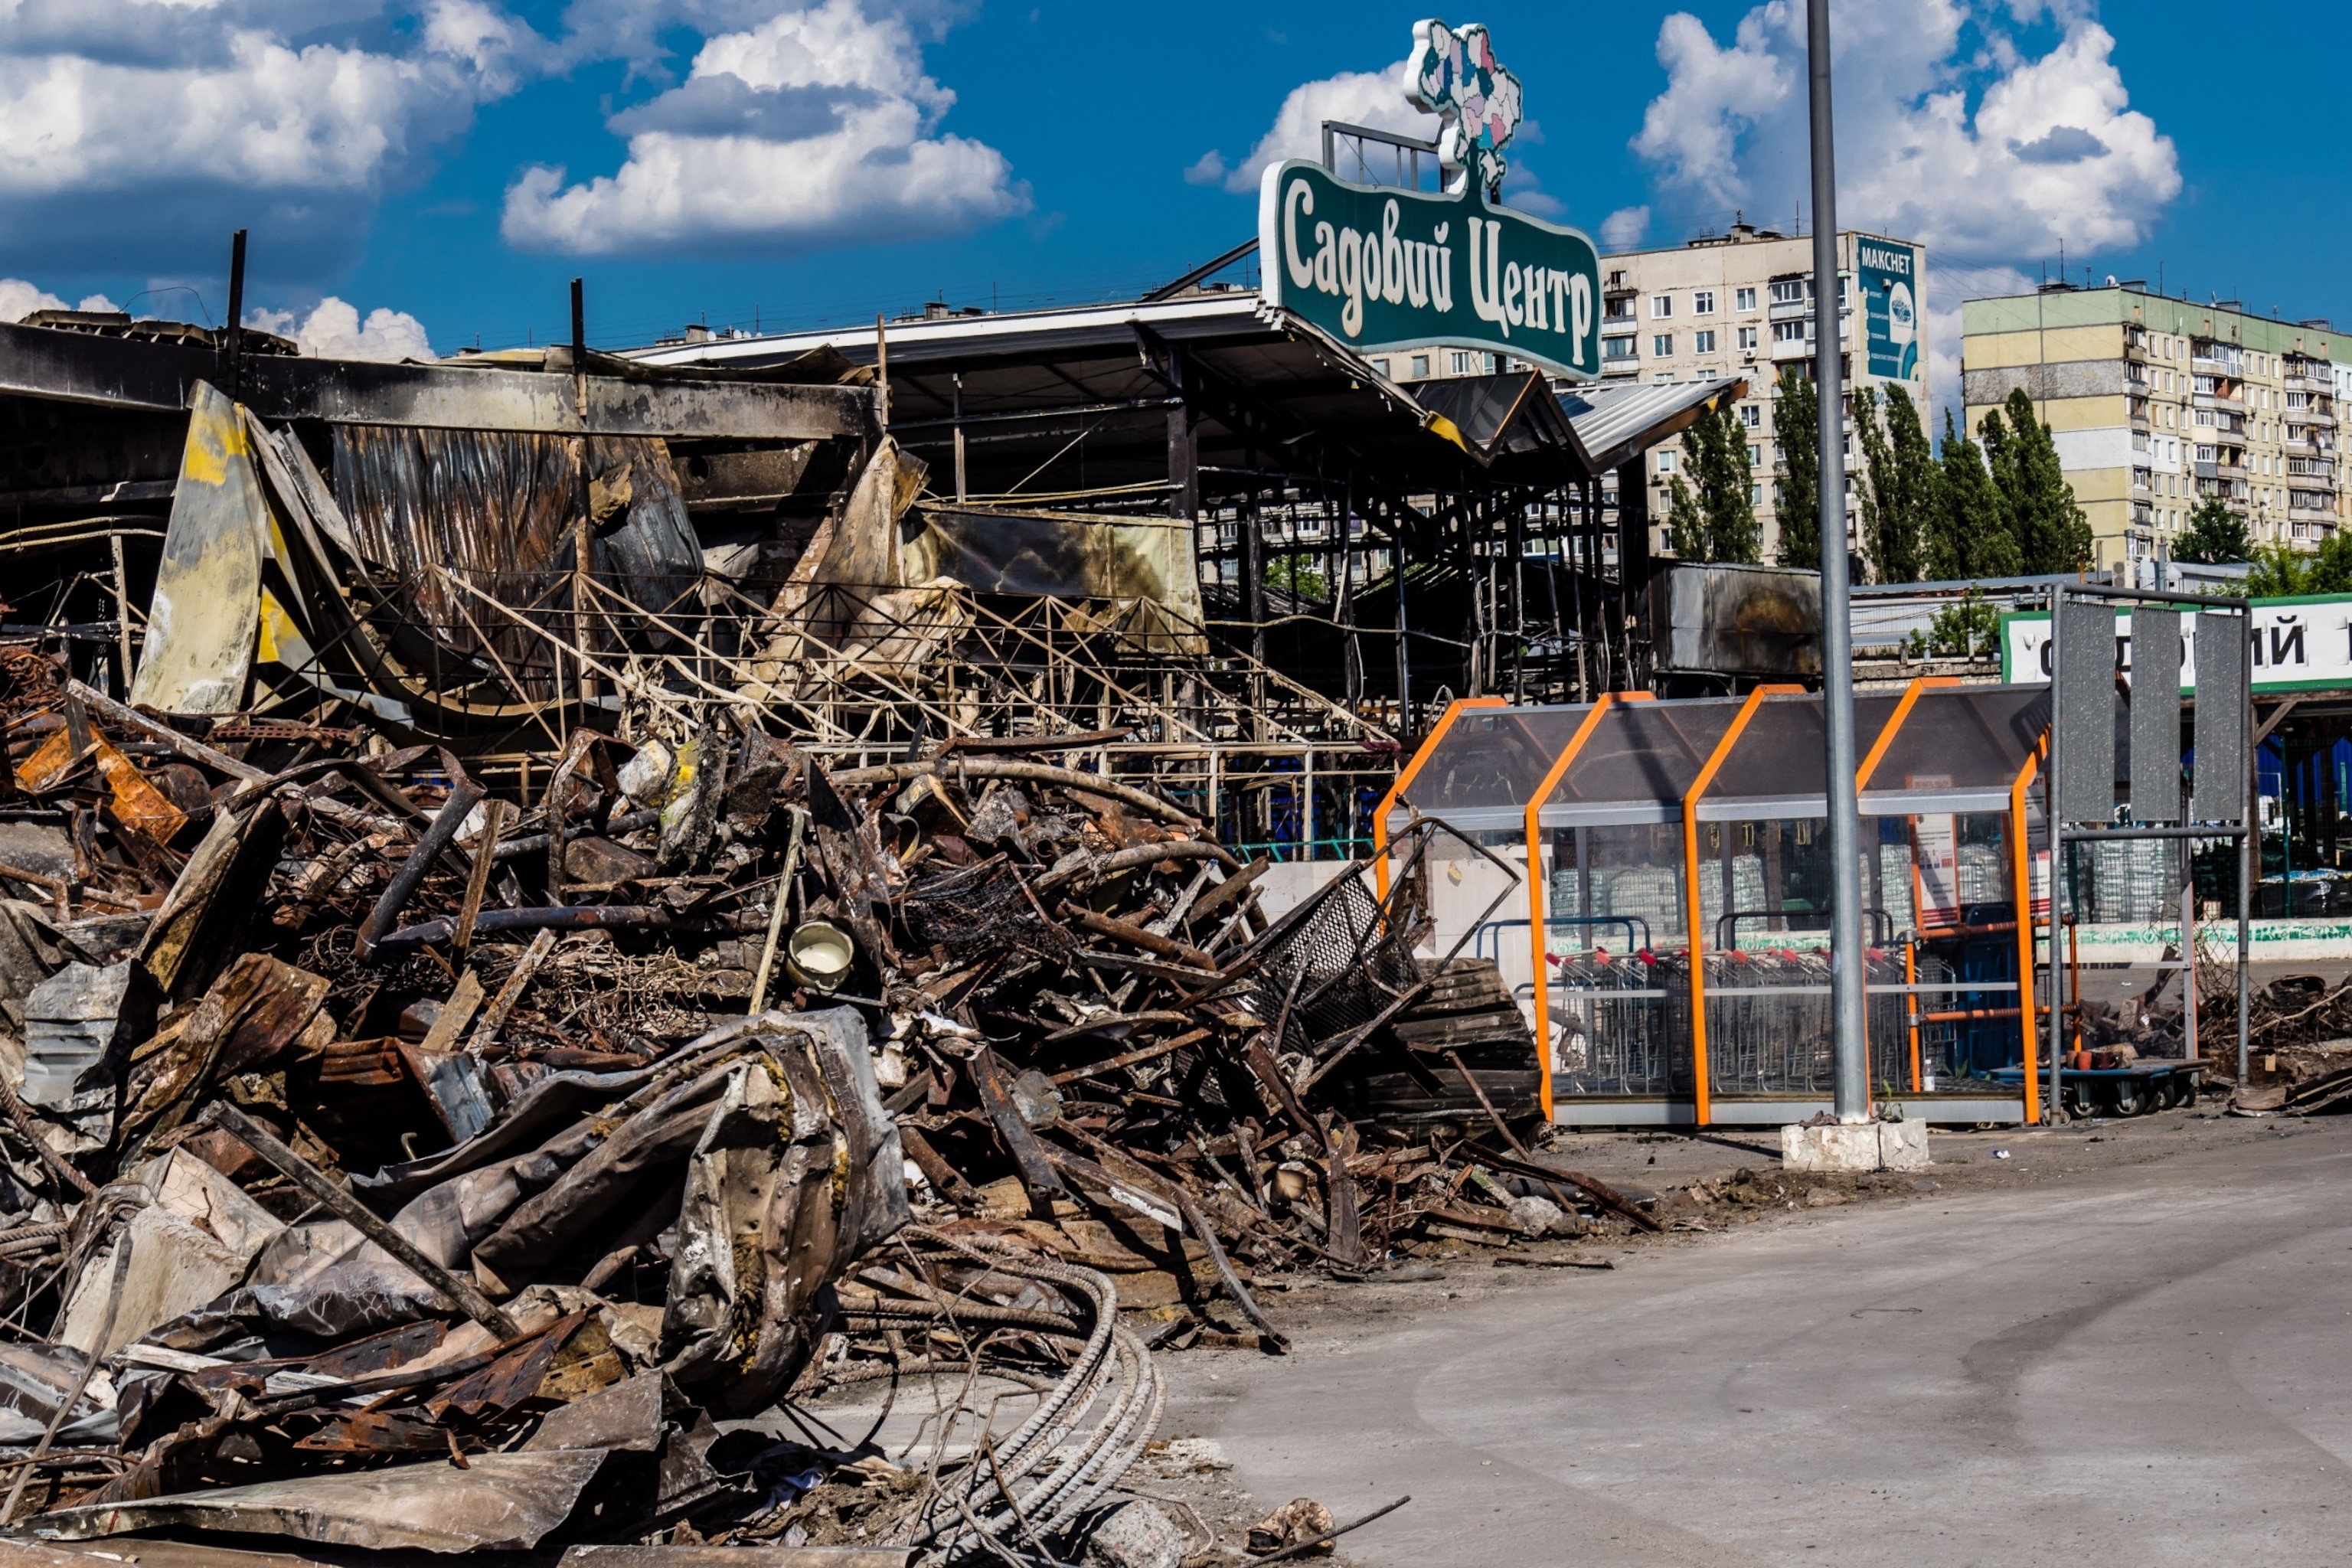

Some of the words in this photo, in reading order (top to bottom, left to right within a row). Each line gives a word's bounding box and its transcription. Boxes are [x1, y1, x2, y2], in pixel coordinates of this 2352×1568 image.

[1285, 178, 1453, 338] Садовий
[1468, 217, 1592, 366] Центр
[1862, 247, 1910, 275] МАКСНЕТ
